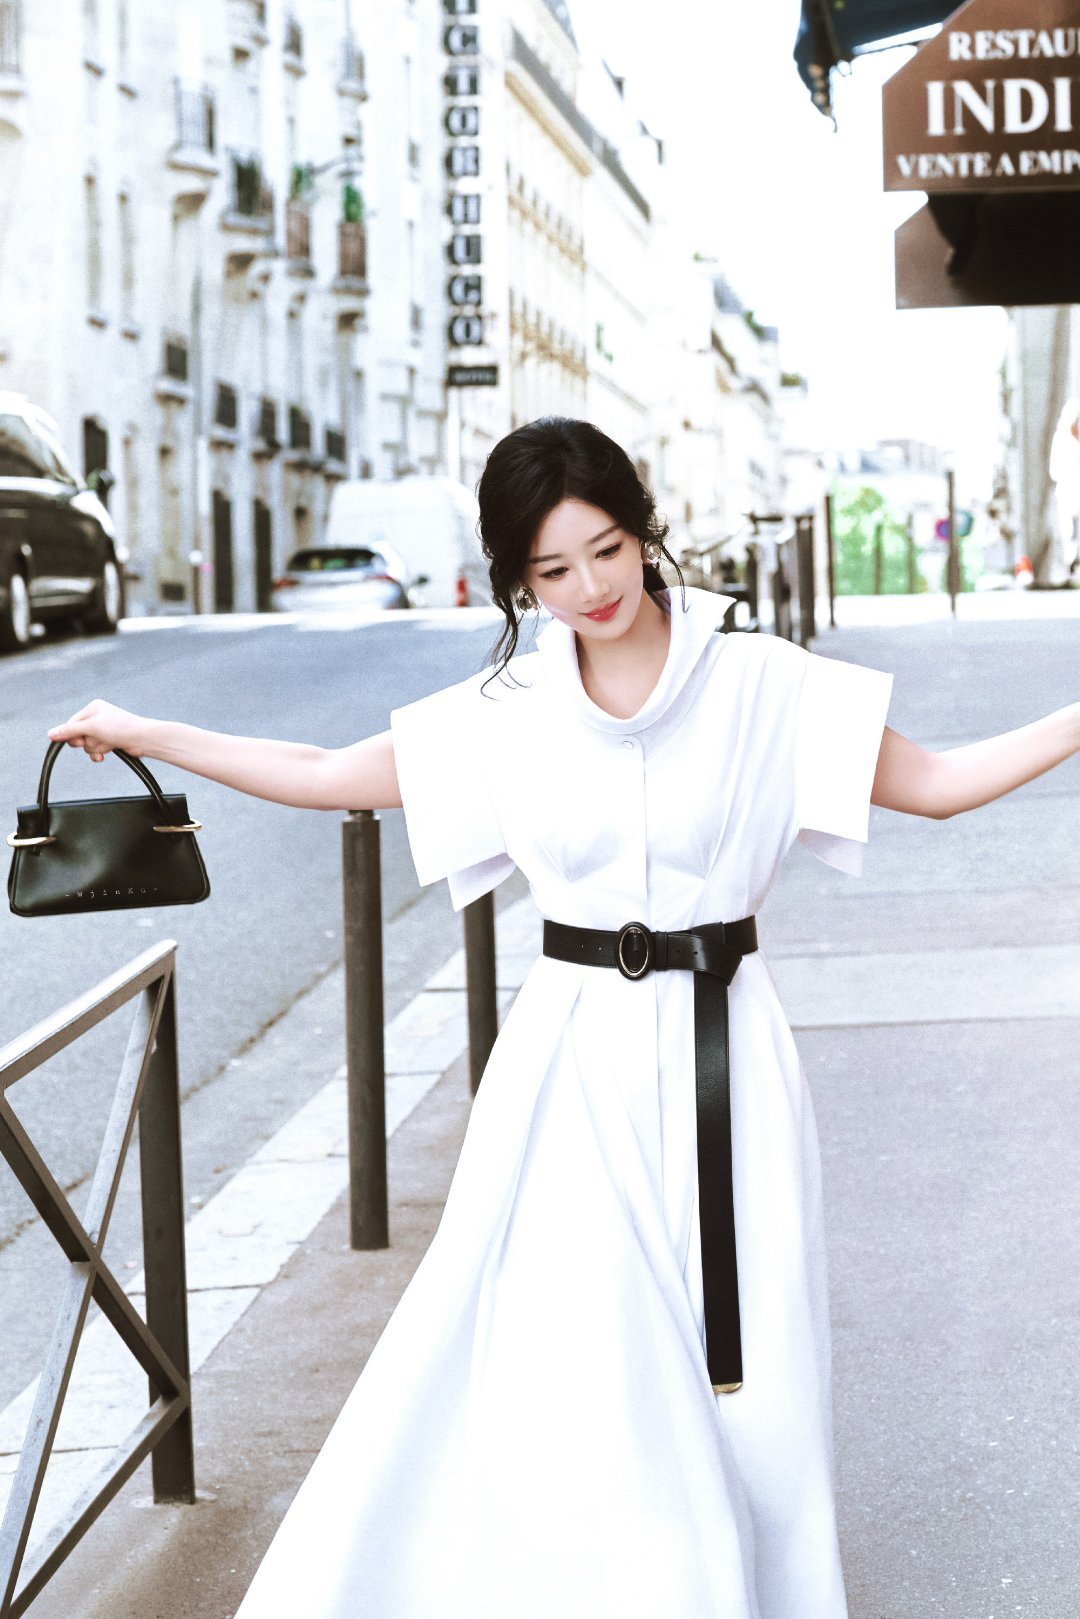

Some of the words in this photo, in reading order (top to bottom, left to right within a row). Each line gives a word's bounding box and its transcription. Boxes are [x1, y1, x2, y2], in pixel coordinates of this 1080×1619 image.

[949, 28, 1080, 61] RESTAU
[926, 77, 1073, 136] INDI
[897, 152, 992, 178] VENTE
[995, 150, 1015, 177] A
[450, 194, 482, 345] HUGO
